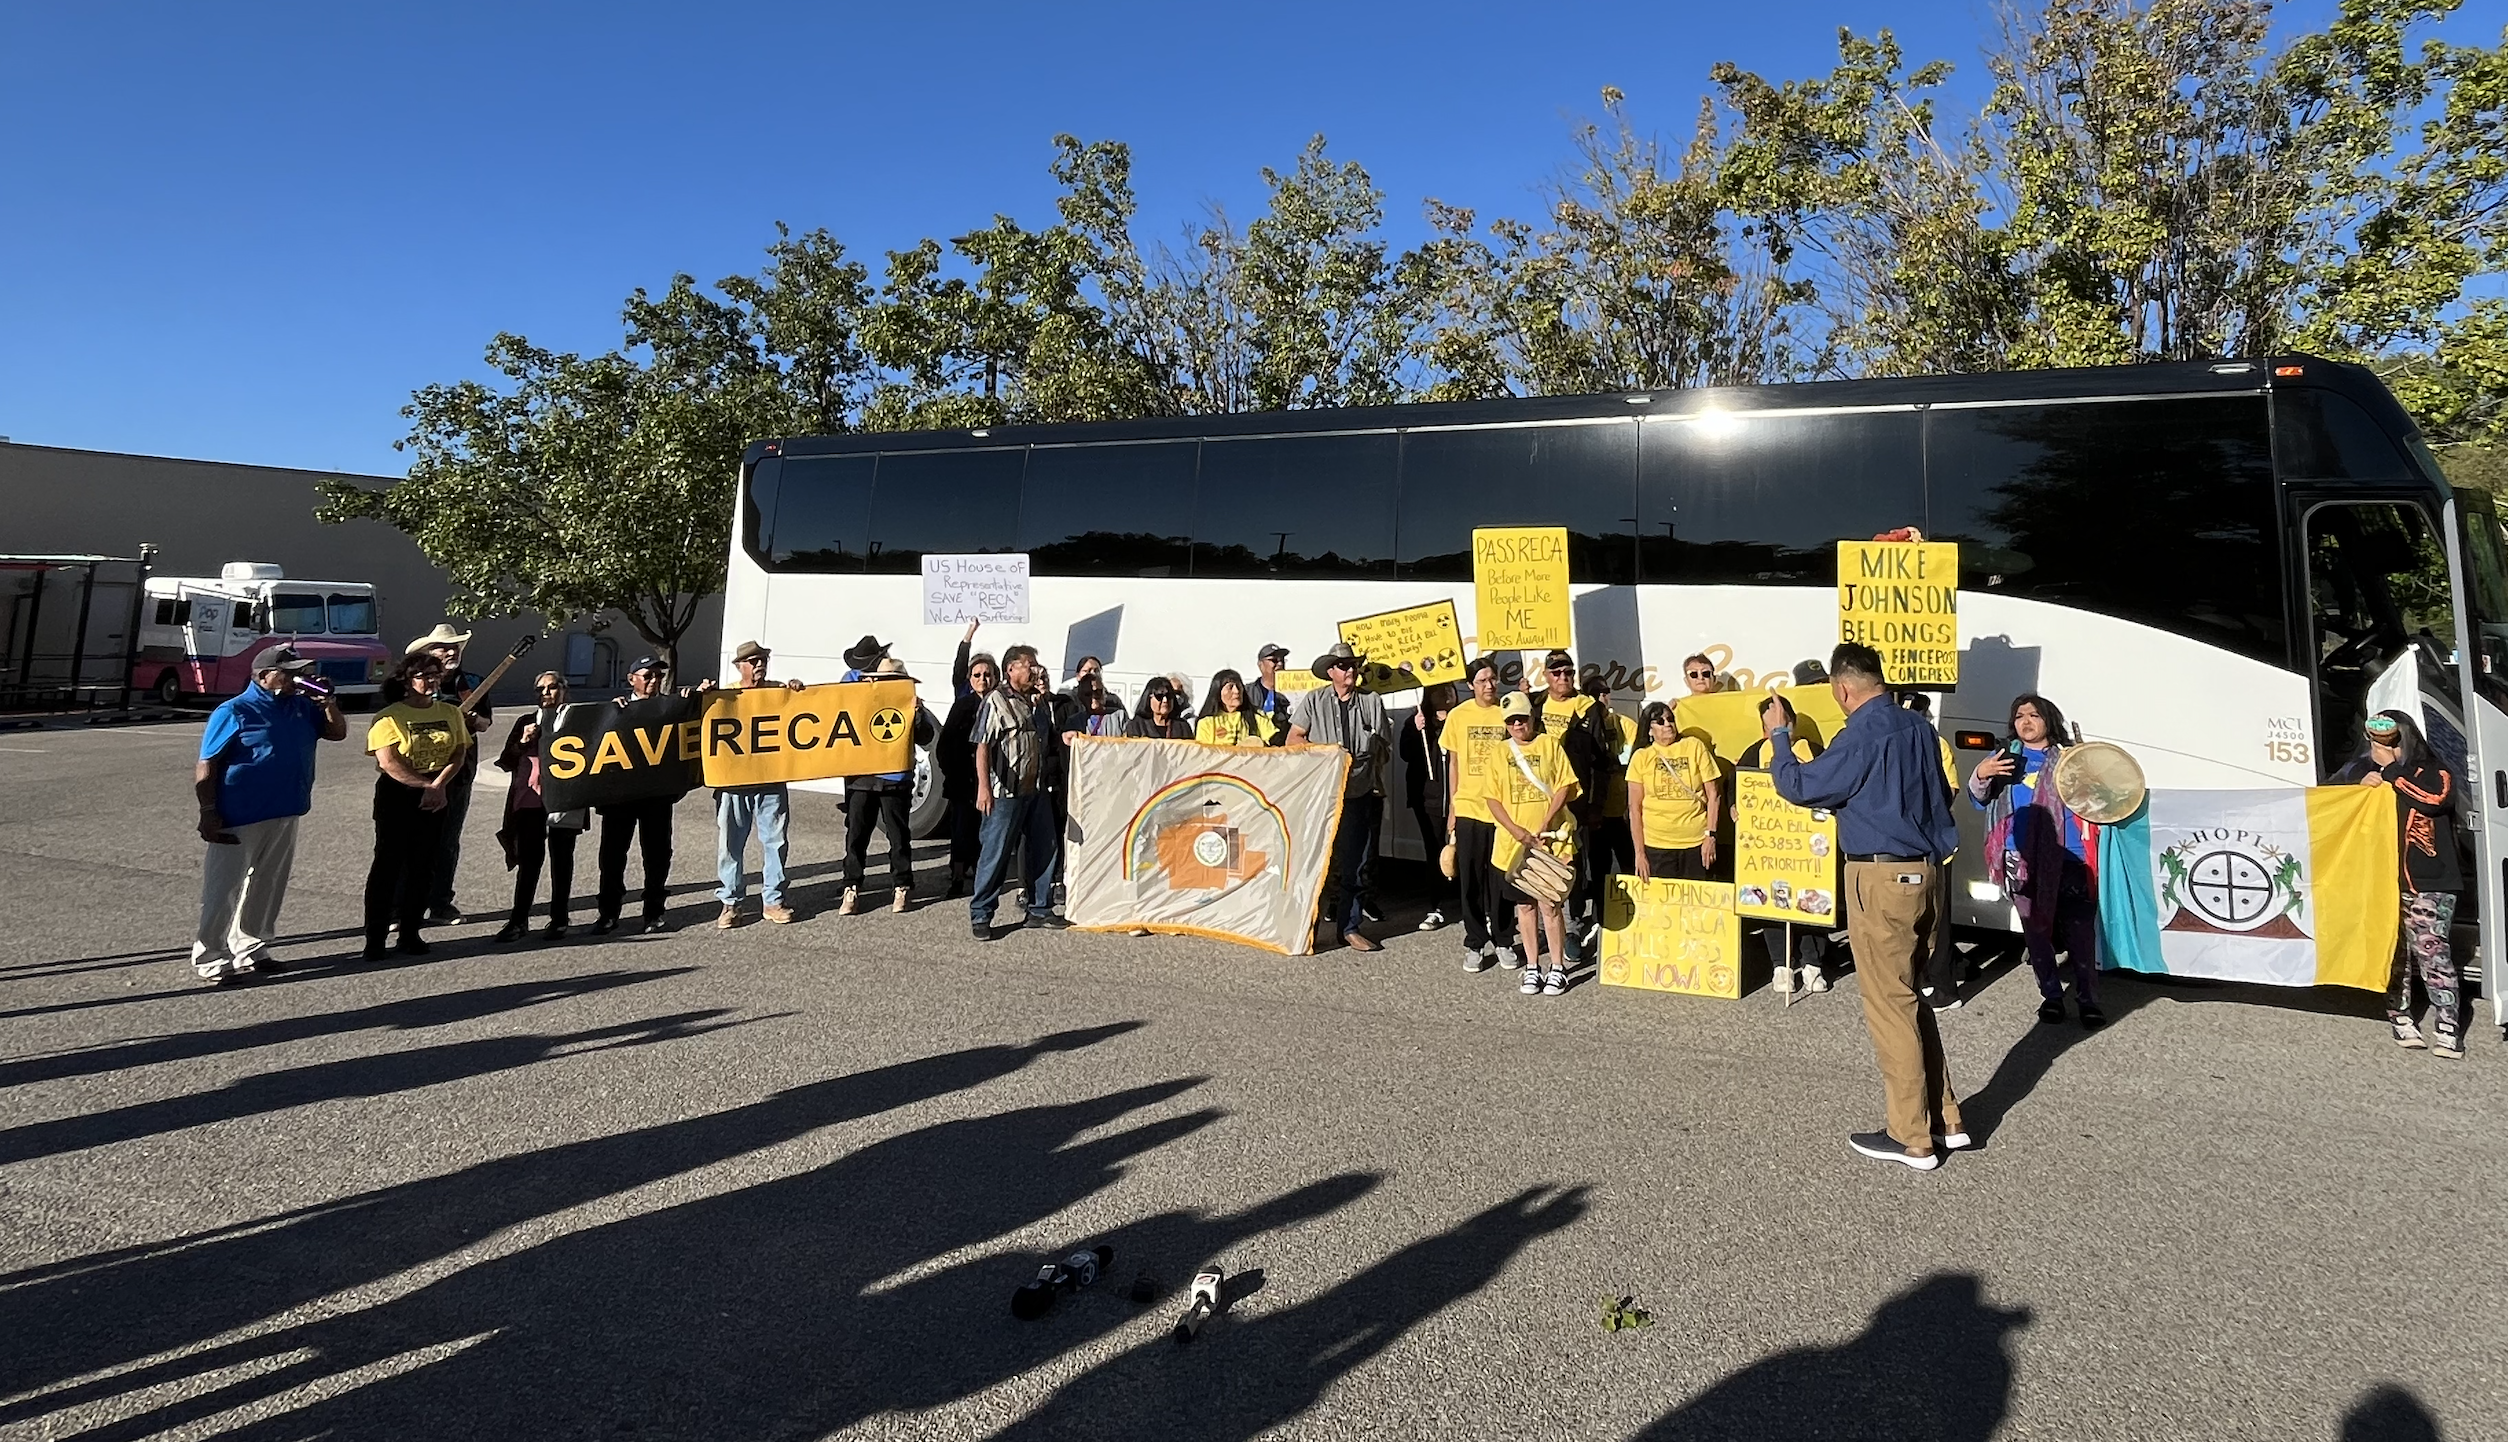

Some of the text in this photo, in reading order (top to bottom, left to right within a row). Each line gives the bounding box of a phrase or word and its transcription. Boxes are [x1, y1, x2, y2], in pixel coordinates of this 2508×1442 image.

[1476, 536, 1562, 564] PASS RECA
[930, 559, 950, 573] US
[957, 559, 1006, 573] House
[1861, 548, 1926, 579] MIKE
[944, 575, 1023, 592] Representative
[1488, 568, 1551, 585] Before More
[930, 592, 963, 604] SAVE
[1490, 586, 1522, 610] People
[1841, 583, 1957, 614] JOHNSON
[199, 605, 219, 620] Pop
[929, 608, 953, 623] We
[1506, 609, 1537, 630] ME
[1356, 622, 1373, 631] HOW
[1842, 619, 1951, 644] BELONGS
[1397, 633, 1422, 645] RECA
[1888, 665, 1957, 682] CONGRESS
[2267, 717, 2302, 730] MCI
[2267, 731, 2305, 740] J4500
[548, 710, 862, 780] SAVE RECA
[2264, 741, 2310, 764] 153
[1742, 776, 1775, 791] Speak
[1760, 798, 1804, 815] MAKE
[1751, 815, 1813, 834] RECA BILL
[1754, 836, 1803, 851] S.3853
[2192, 827, 2263, 848] HOPI
[1744, 855, 1757, 871] A
[1660, 883, 1731, 904] JOHNSON
[1643, 963, 1701, 990] NOW!
